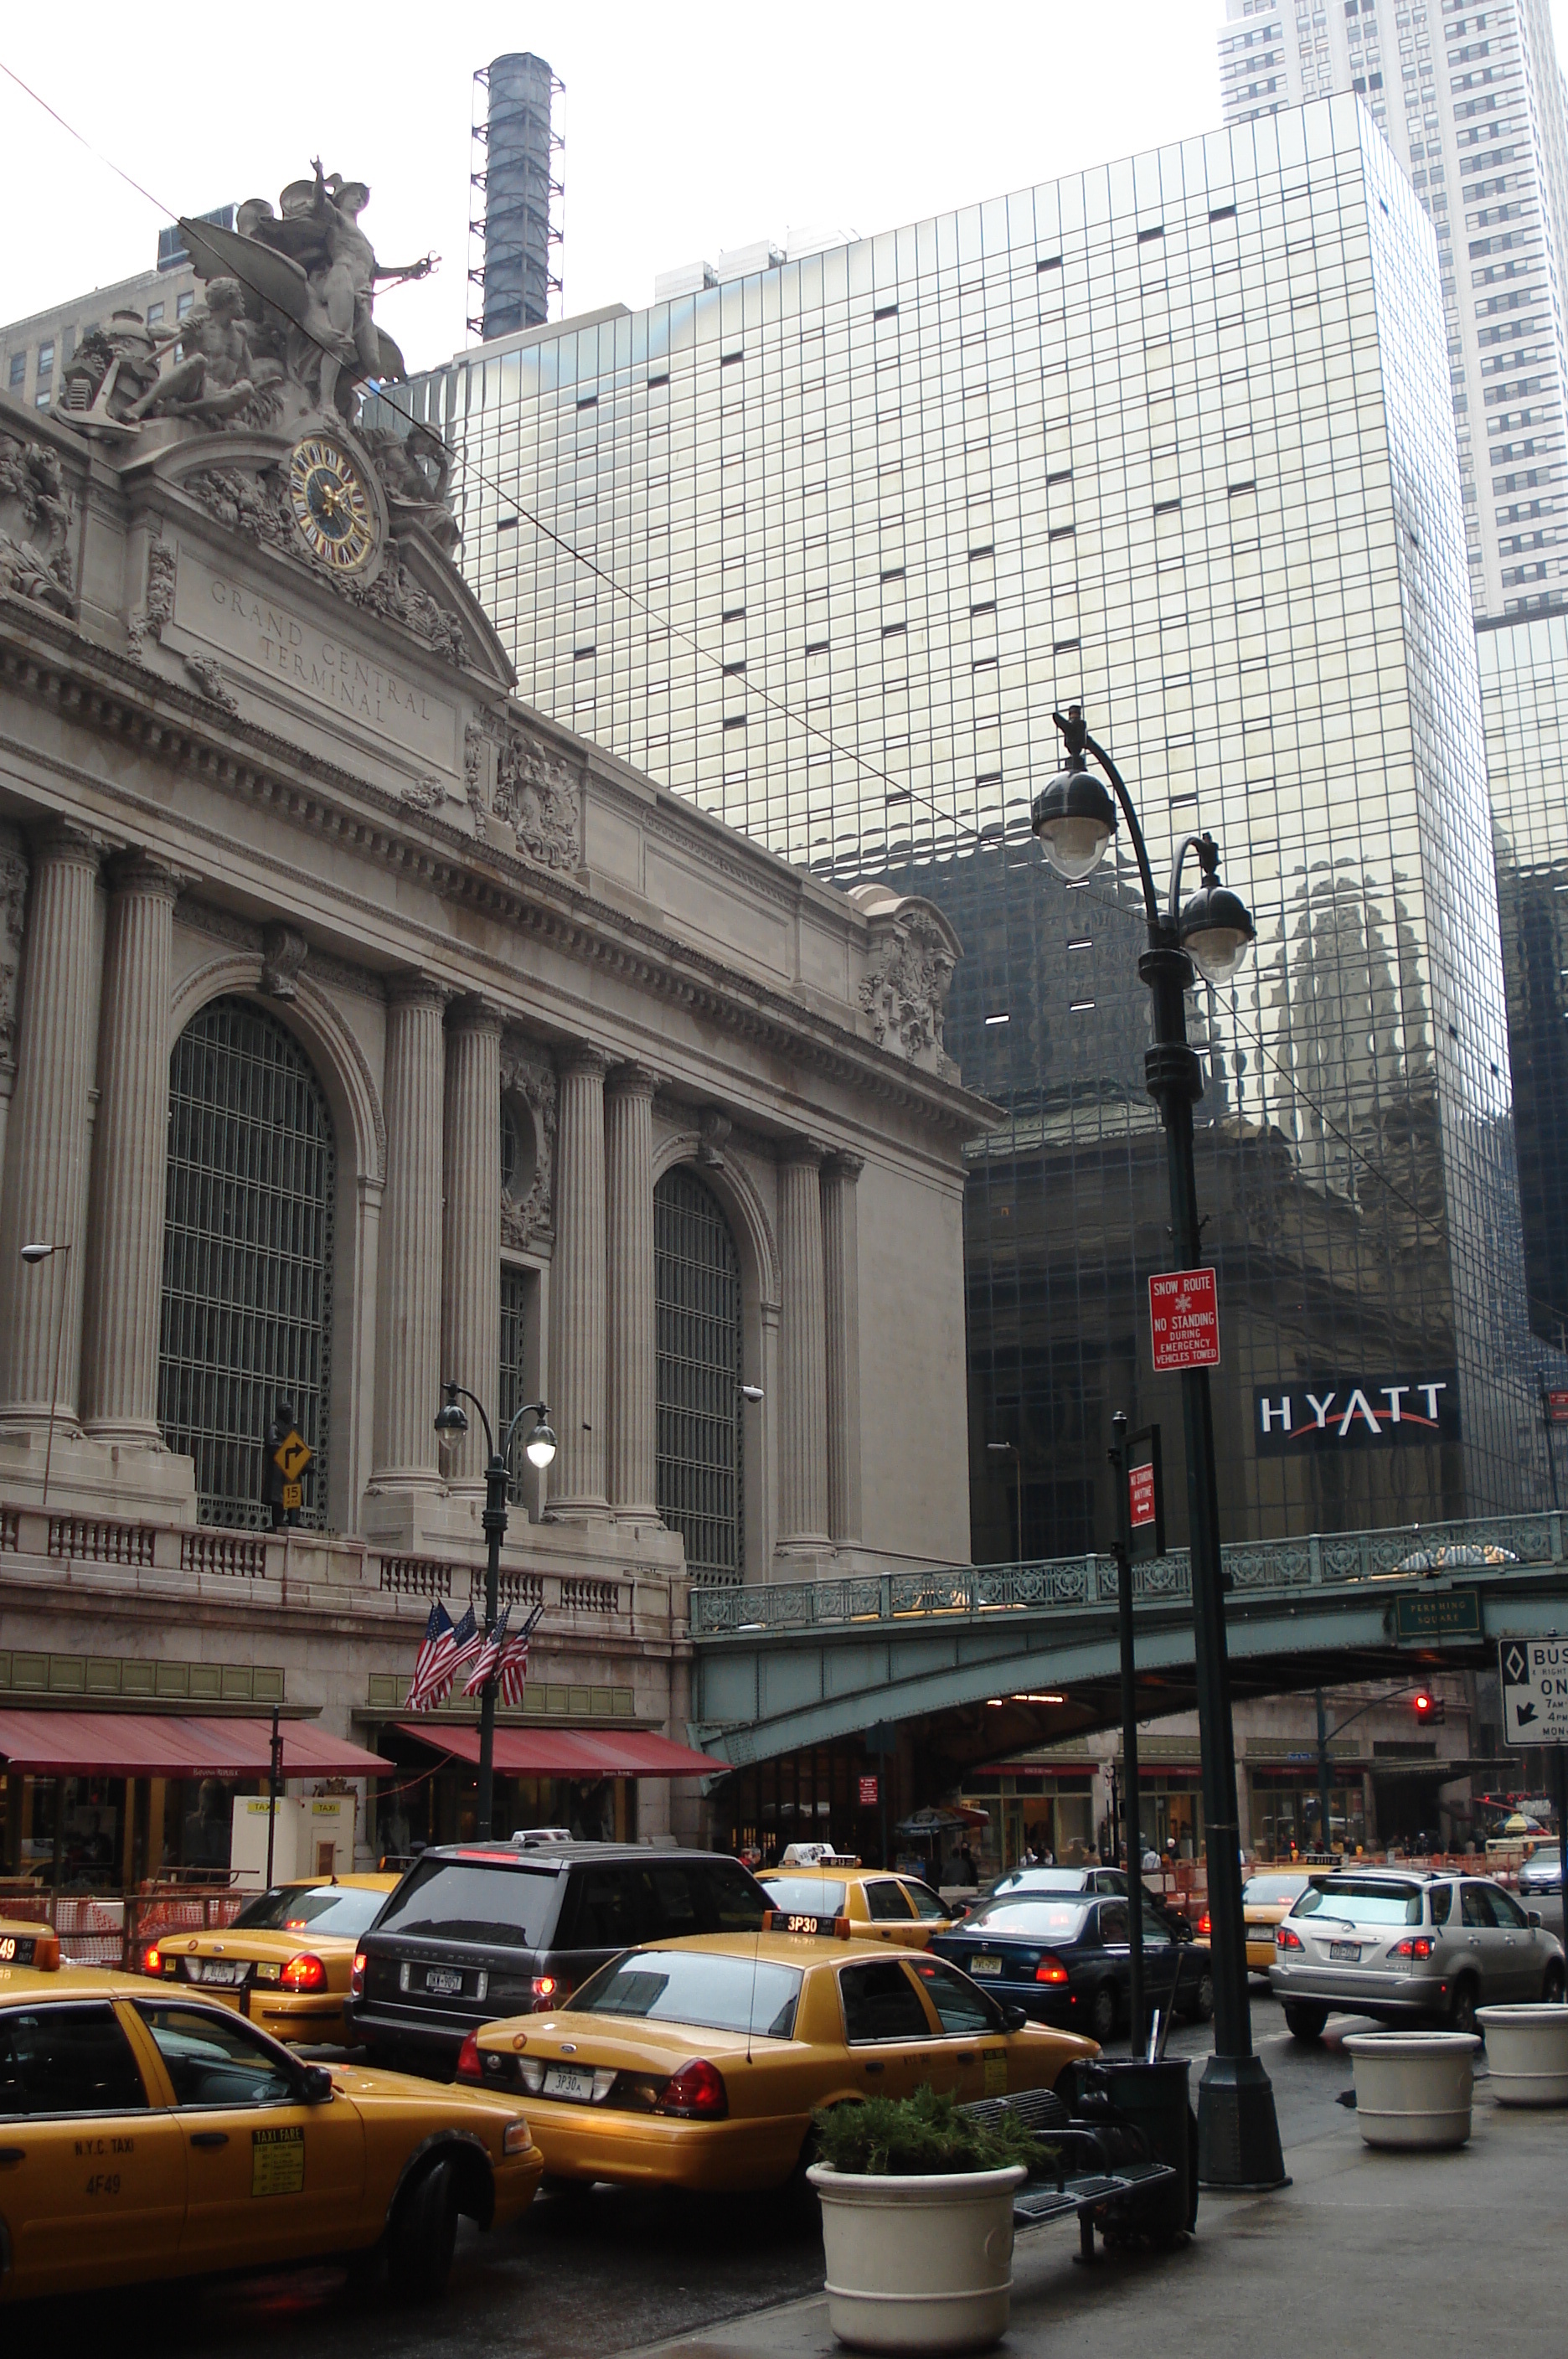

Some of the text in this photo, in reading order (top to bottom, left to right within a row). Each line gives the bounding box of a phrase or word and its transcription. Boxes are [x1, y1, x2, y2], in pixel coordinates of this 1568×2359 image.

[212, 581, 430, 720] GRAND CENTRAL
[261, 636, 385, 723] TERMINAL
[1153, 1276, 1211, 1296] SNOW ROUTE
[1154, 1312, 1215, 1332] NO STANDING
[1169, 1329, 1200, 1341] DURING
[1160, 1339, 1210, 1354] EMERGENCY
[1156, 1348, 1217, 1365] VEHICLES TOWED
[1260, 1382, 1447, 1437] HYATT
[1411, 1600, 1467, 1613] PERSHING
[1418, 1613, 1459, 1624] SQUARE
[787, 1915, 818, 1933] 3P30
[22, 1940, 33, 1950] OFF
[18, 1952, 32, 1961] DUTY
[255, 2128, 301, 2144] TAXI FARE
[75, 2137, 134, 2155] N.Y.C. TAXI
[86, 2173, 121, 2196] 4F49
